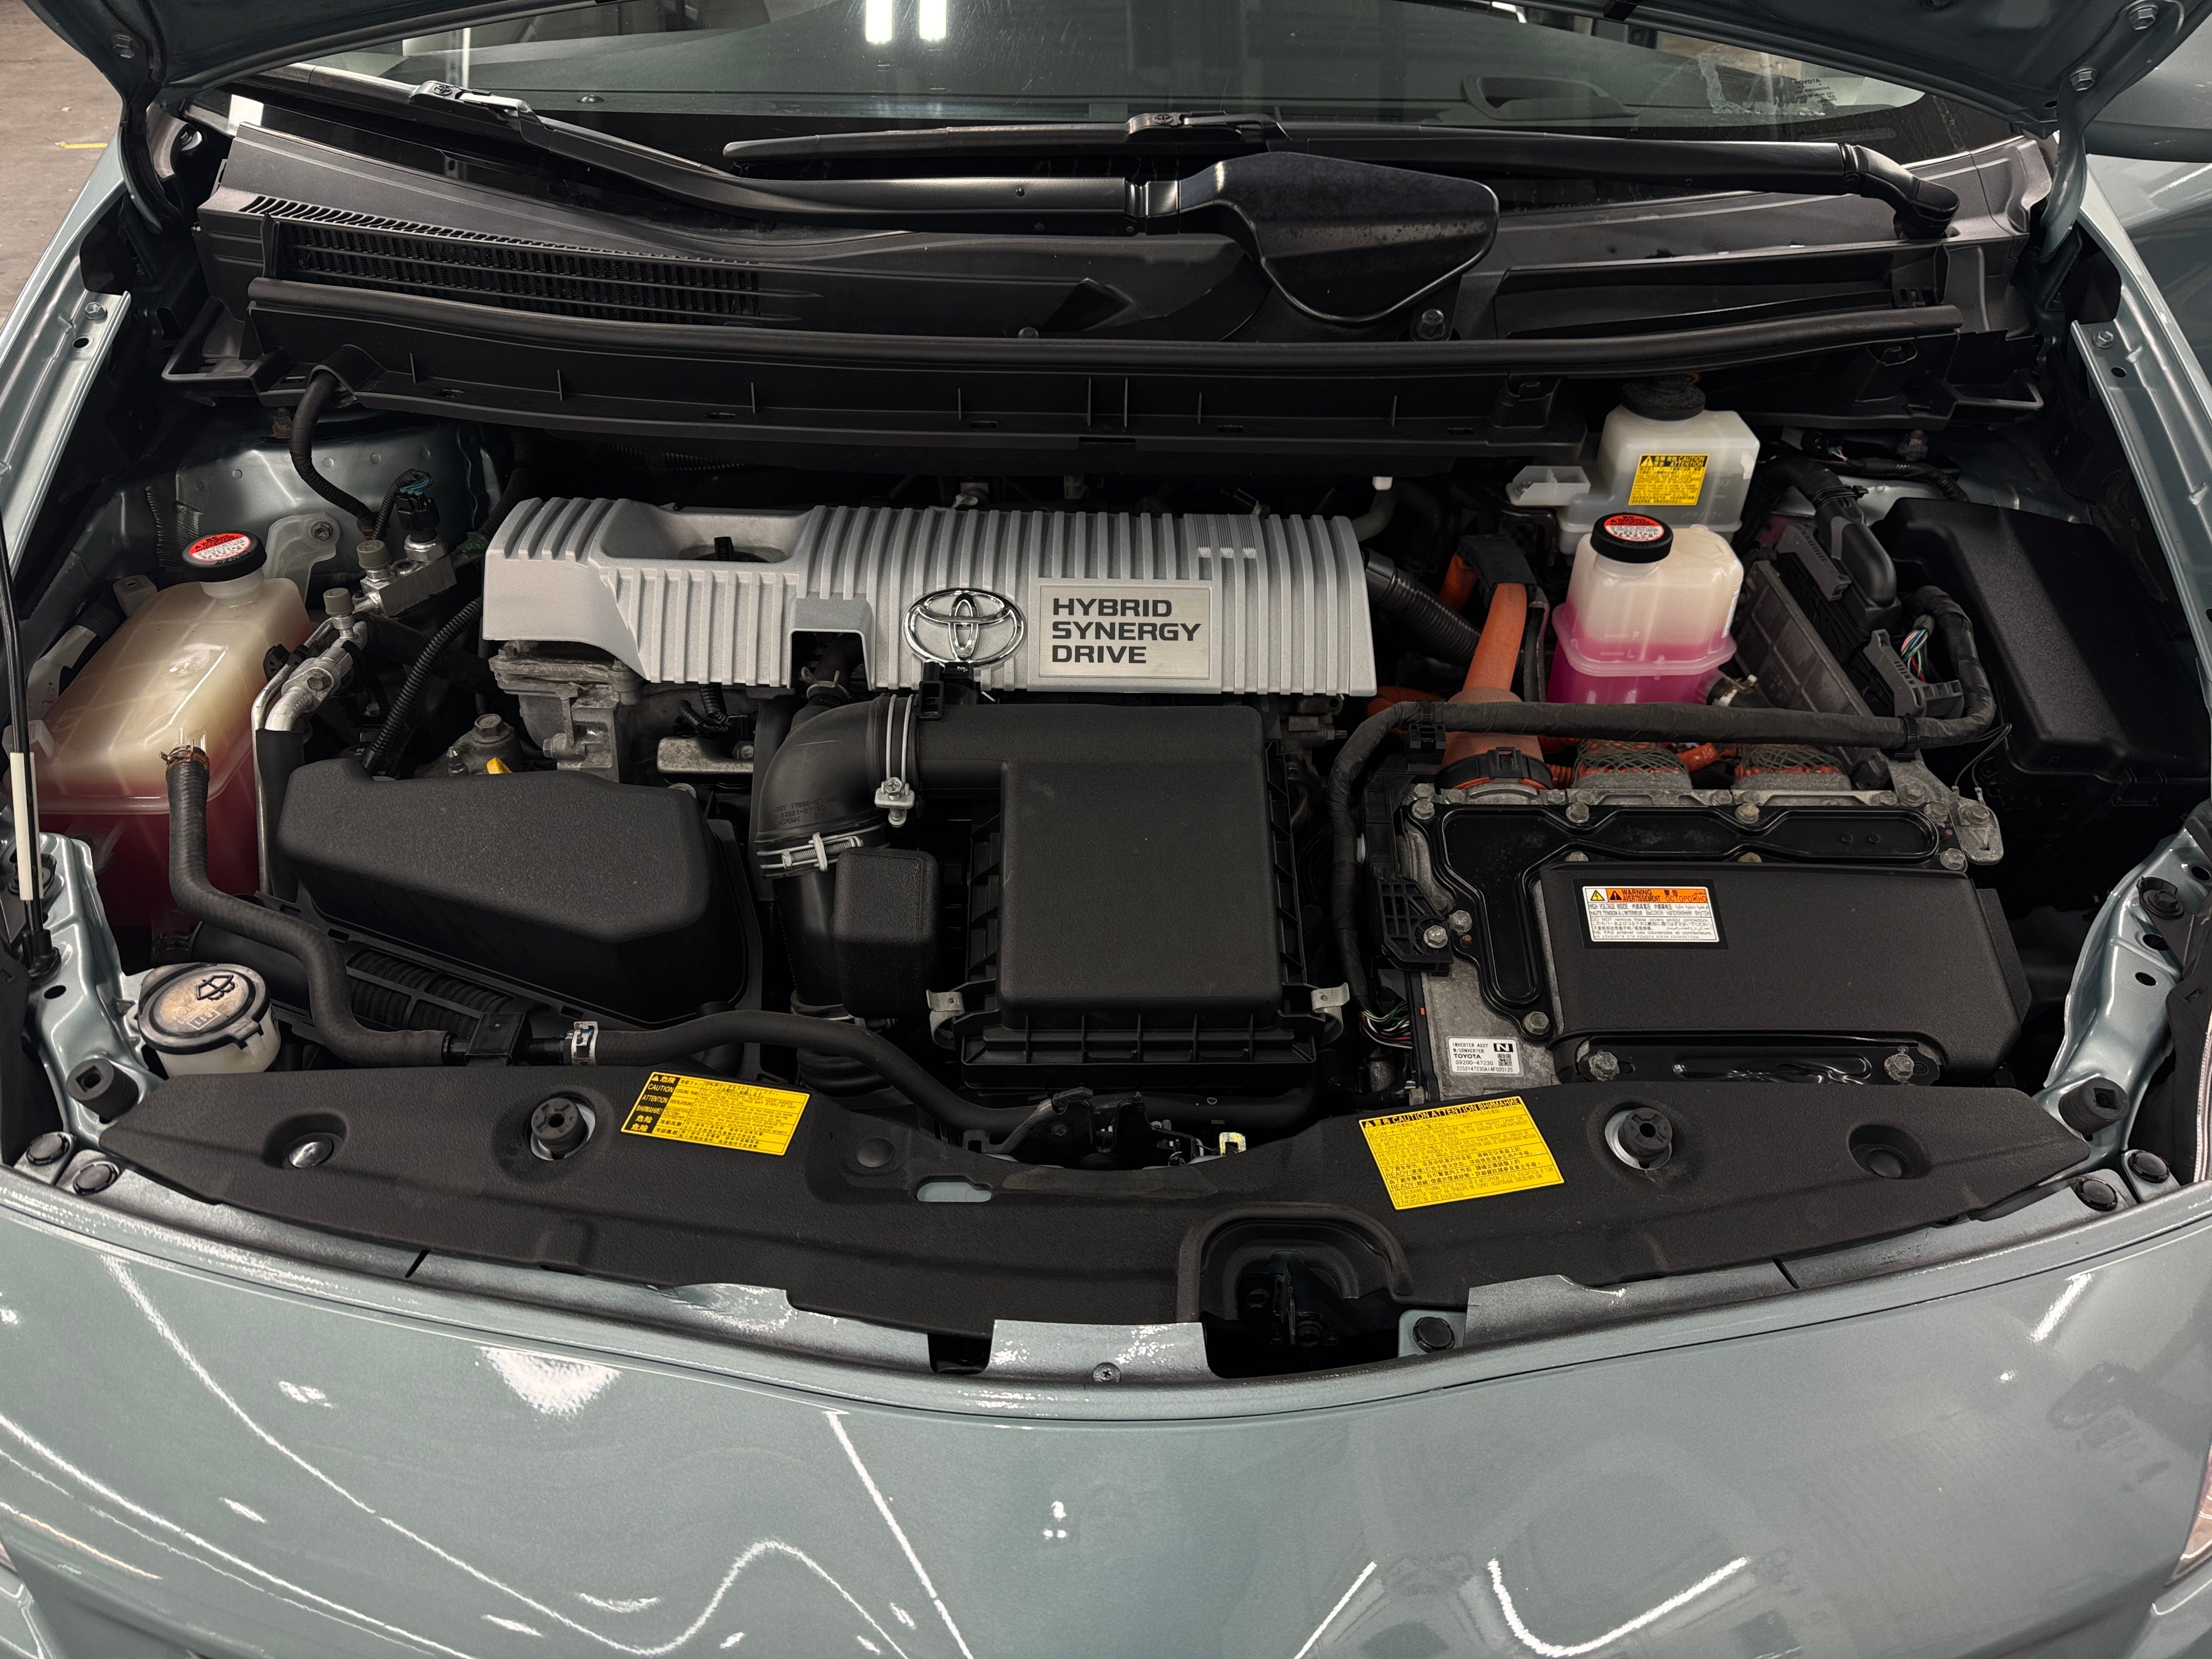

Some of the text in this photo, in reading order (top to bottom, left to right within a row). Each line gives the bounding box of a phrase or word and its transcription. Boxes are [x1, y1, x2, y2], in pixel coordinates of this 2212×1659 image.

[1053, 598, 1172, 617] HYBRID
[1052, 621, 1201, 641] SYNERGY
[1632, 630, 1640, 641] F
[1052, 645, 1147, 664] DRIVE
[1627, 649, 1634, 659] L
[646, 1083, 675, 1093] CAUTION
[641, 1093, 669, 1104] ATTENTION
[1391, 1111, 1431, 1124] CAUTION
[1429, 1104, 1478, 1118] ATTENTION
[1477, 1098, 1520, 1110] ВНИМАНИЕ
